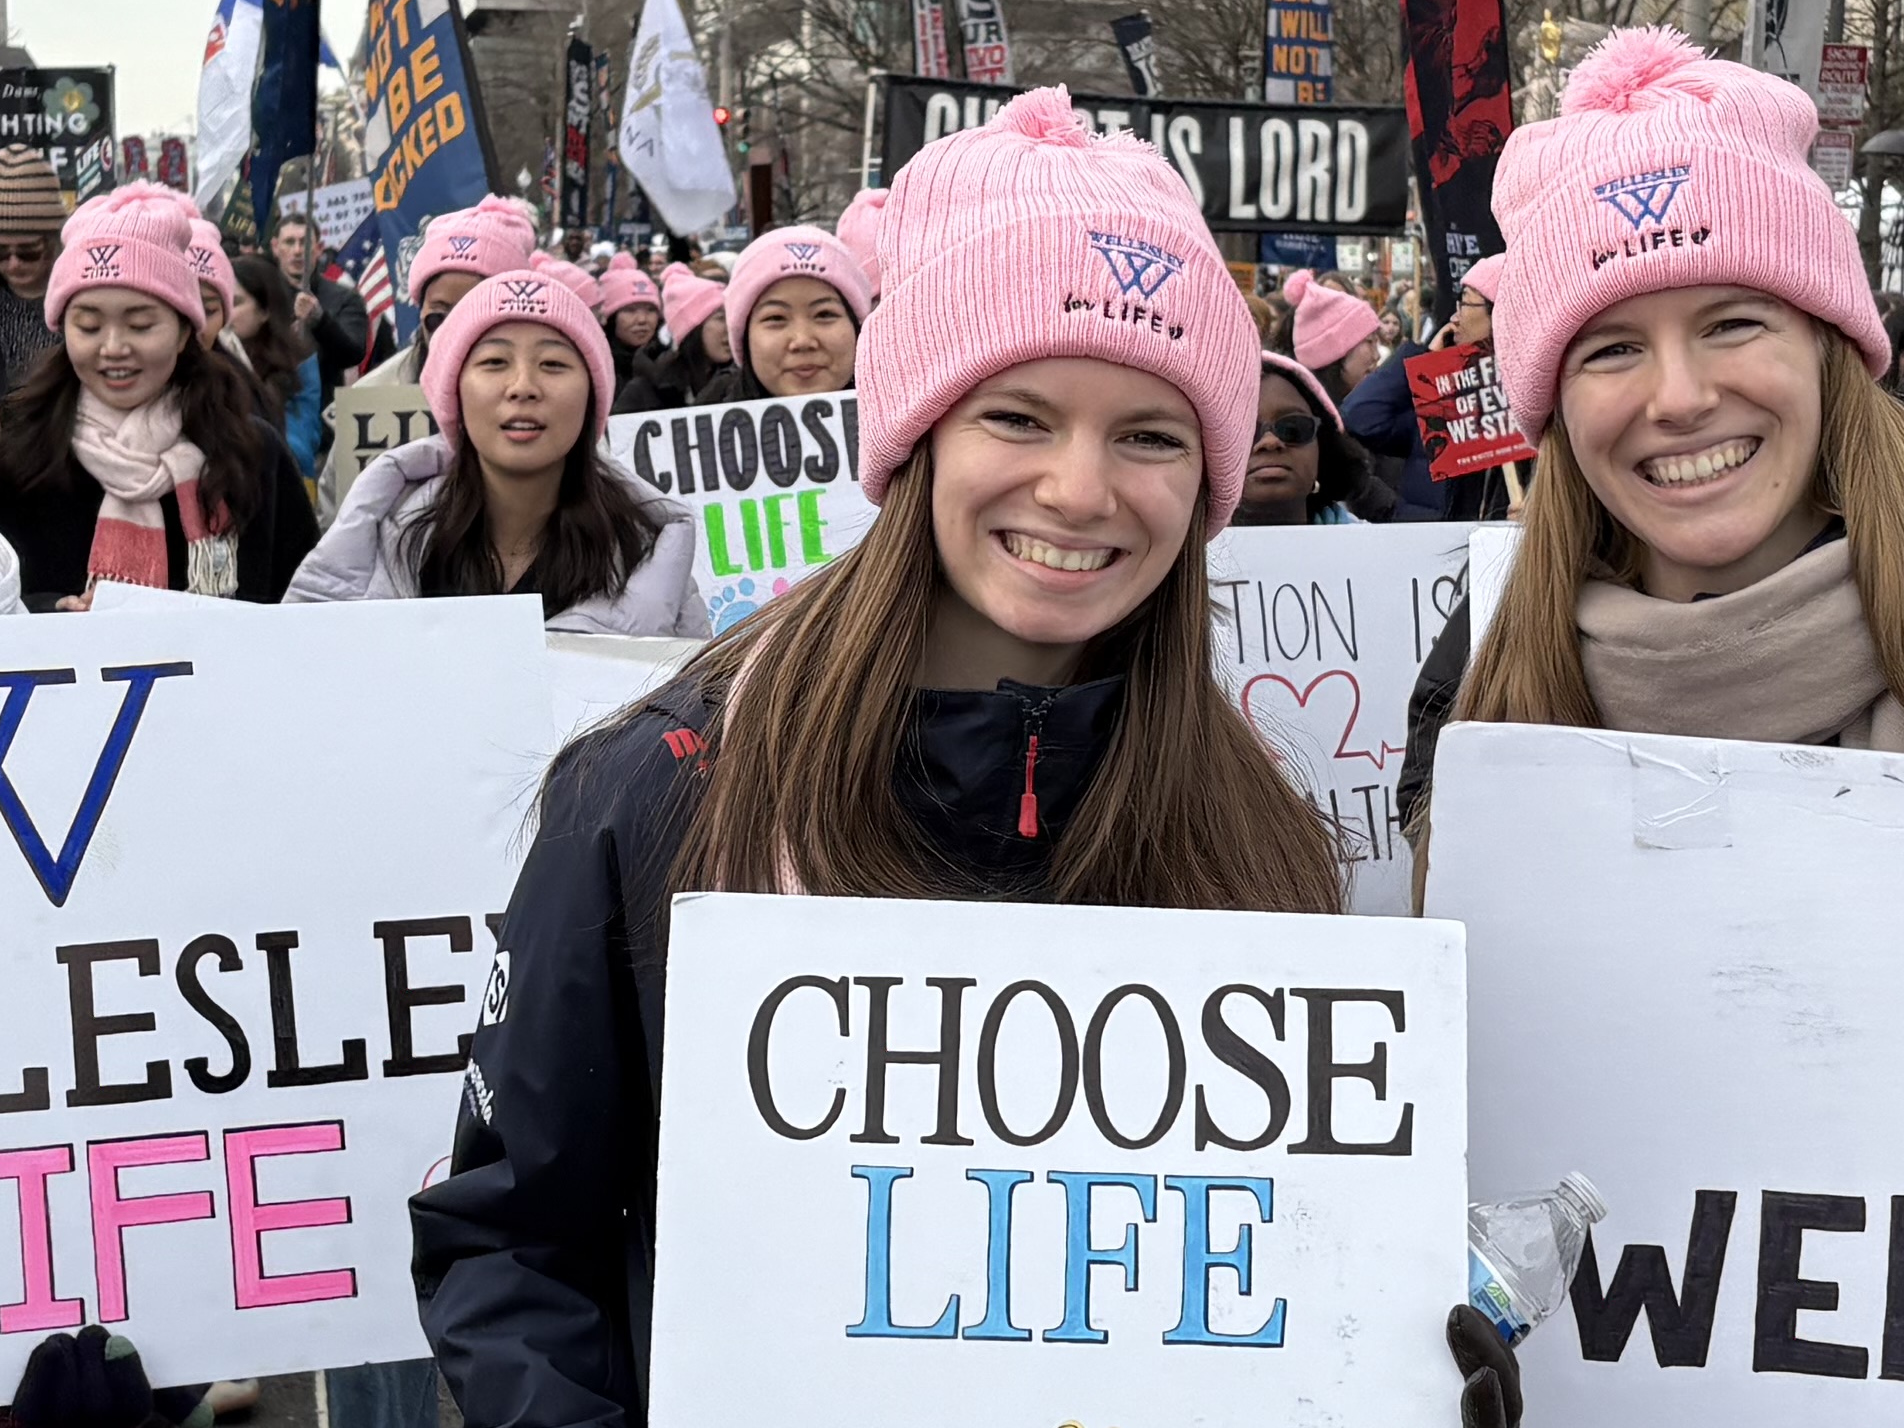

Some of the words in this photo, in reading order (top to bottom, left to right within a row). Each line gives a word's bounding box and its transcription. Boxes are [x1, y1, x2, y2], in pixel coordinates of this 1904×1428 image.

[1280, 9, 1330, 42] WILL
[1272, 44, 1320, 76] NOT
[387, 35, 444, 135] BE
[373, 90, 466, 214] OCKED
[1228, 116, 1370, 223] LORD
[1597, 177, 1690, 232] W
[86, 244, 123, 266] W
[1090, 244, 1182, 301] W
[1591, 248, 1618, 272] for
[1623, 228, 1684, 259] LIFE
[497, 280, 548, 299] W
[1062, 291, 1096, 314] for
[1103, 300, 1163, 335] LIFE
[1435, 375, 1452, 398] IN
[1454, 369, 1480, 392] THE
[1455, 396, 1478, 416] OF
[1478, 386, 1511, 413] EV
[1446, 420, 1480, 445] WE
[1479, 409, 1524, 439] STA
[703, 486, 835, 578] LIFE
[1213, 577, 1360, 665] TION
[745, 972, 1415, 1156] CHOOSE
[844, 1163, 1288, 1348] LIFE
